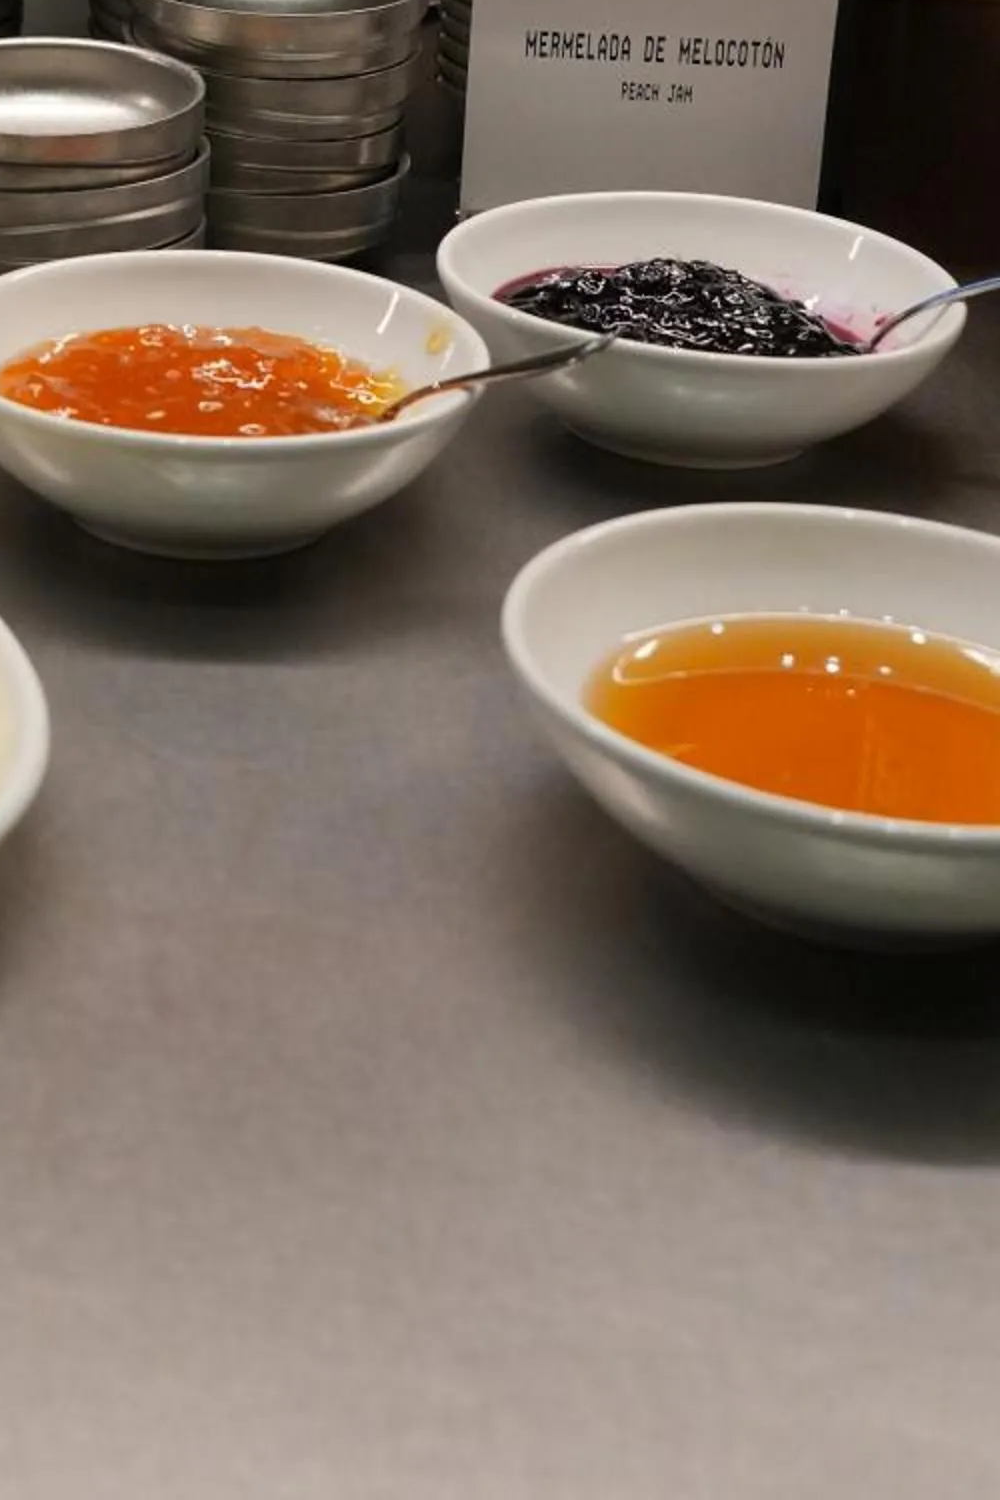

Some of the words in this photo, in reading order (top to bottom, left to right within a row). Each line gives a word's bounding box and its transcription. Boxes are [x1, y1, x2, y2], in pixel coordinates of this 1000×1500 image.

[525, 29, 632, 62] MERMELADA
[643, 34, 667, 64] DE
[678, 35, 785, 69] MELOCOTÓN
[620, 81, 659, 101] PEACH
[666, 83, 693, 104] JAM
